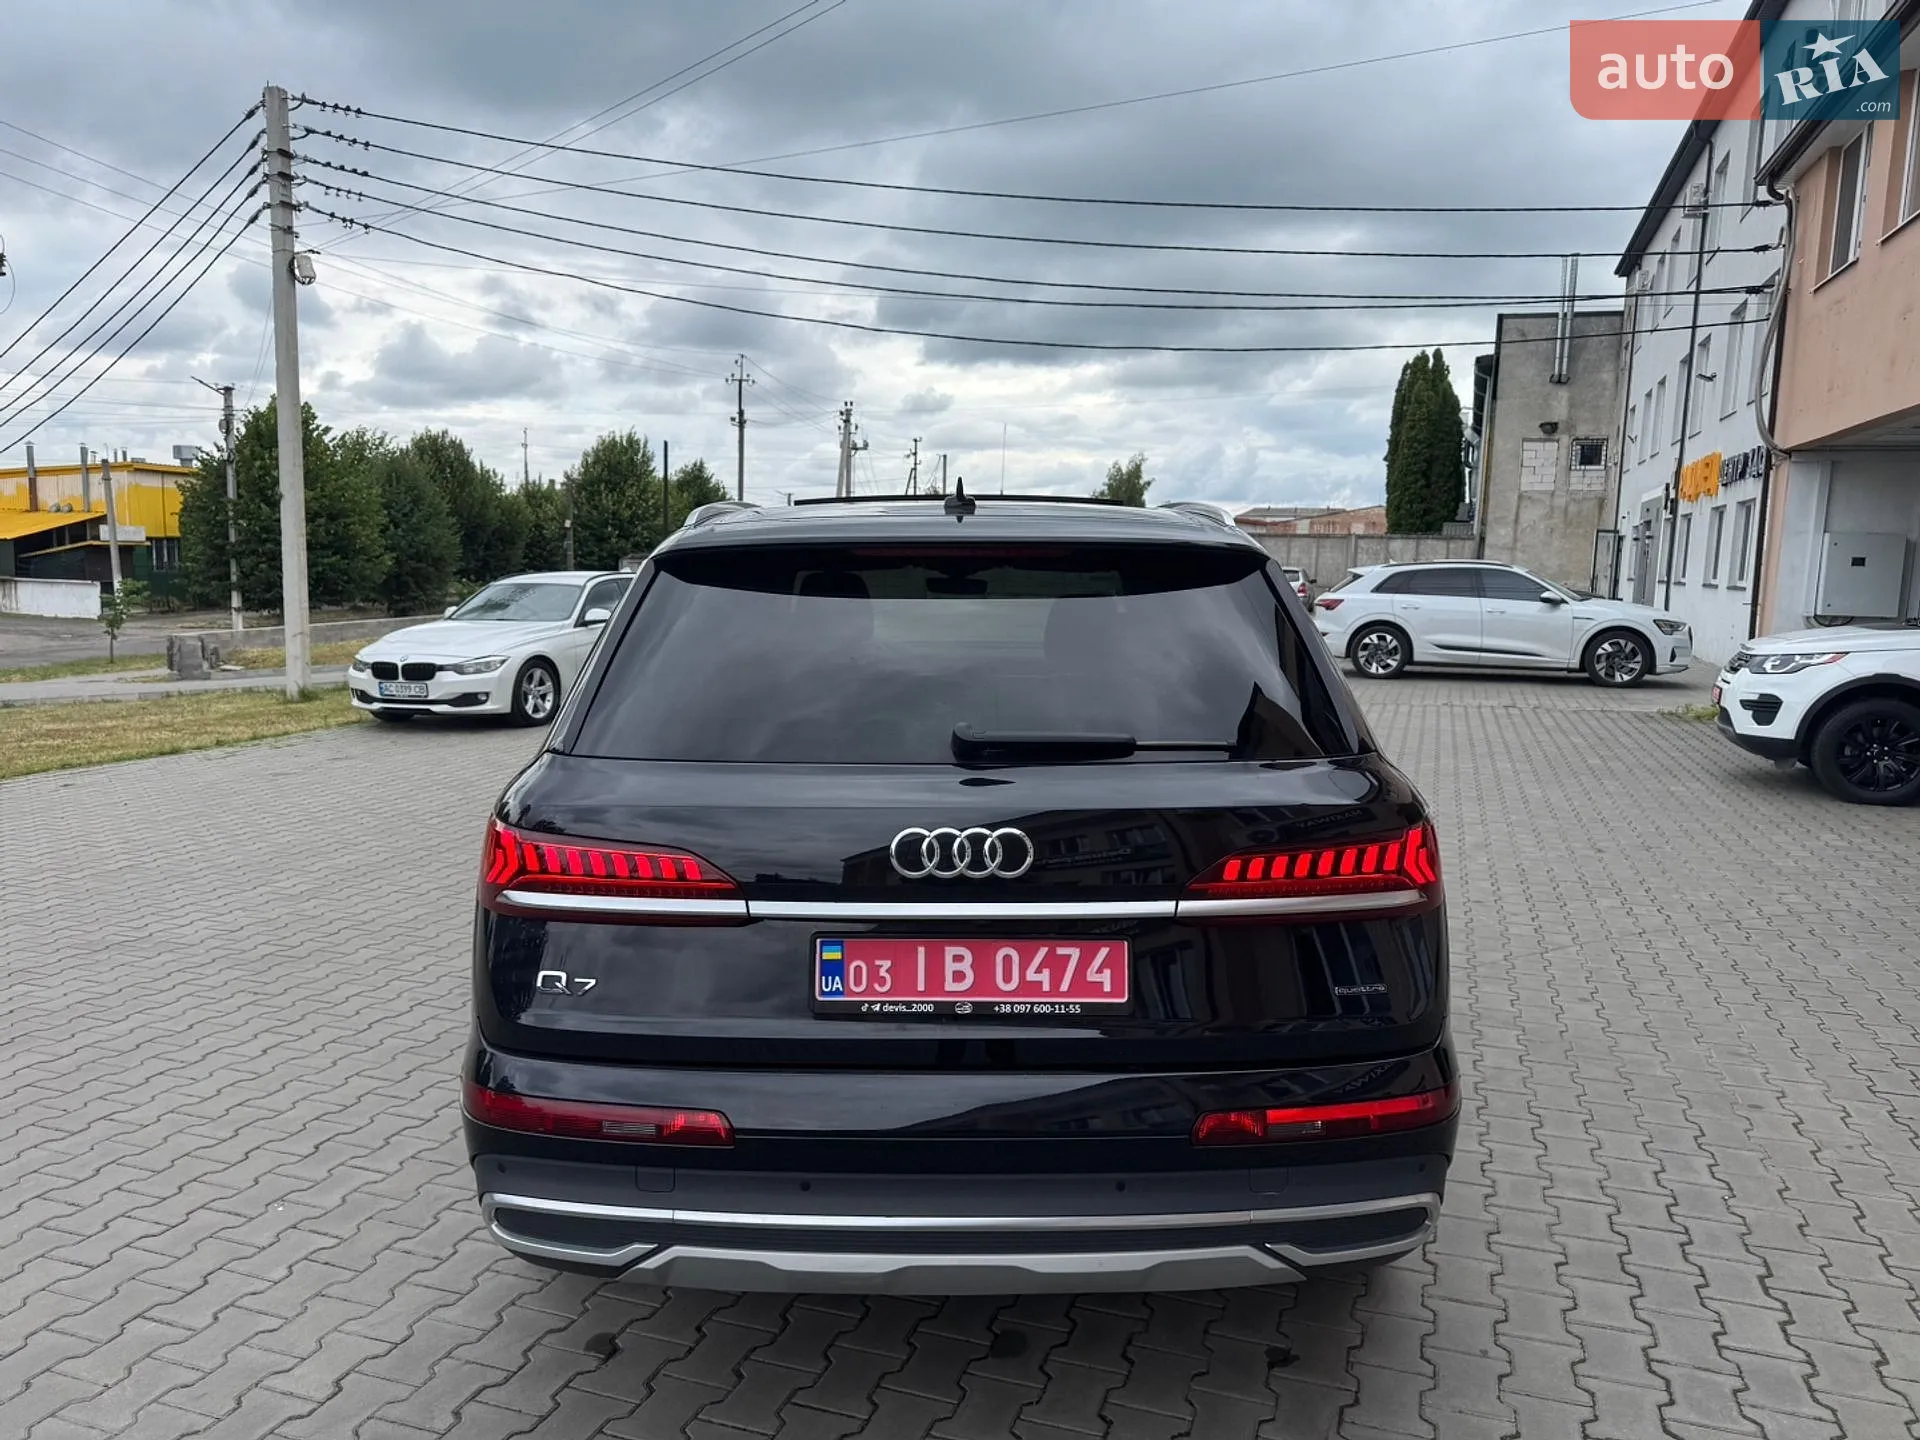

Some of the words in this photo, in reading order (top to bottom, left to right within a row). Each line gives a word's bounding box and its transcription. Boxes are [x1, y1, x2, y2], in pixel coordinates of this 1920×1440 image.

[821, 976, 843, 992] UA
[849, 960, 893, 993] 03
[994, 946, 1112, 992] 0474
[536, 970, 597, 995] Q7
[882, 1003, 934, 1012] devis_2000
[993, 1004, 1012, 1013] +38
[1013, 1004, 1031, 1013] 097
[1033, 1004, 1081, 1013] 600-11-55
